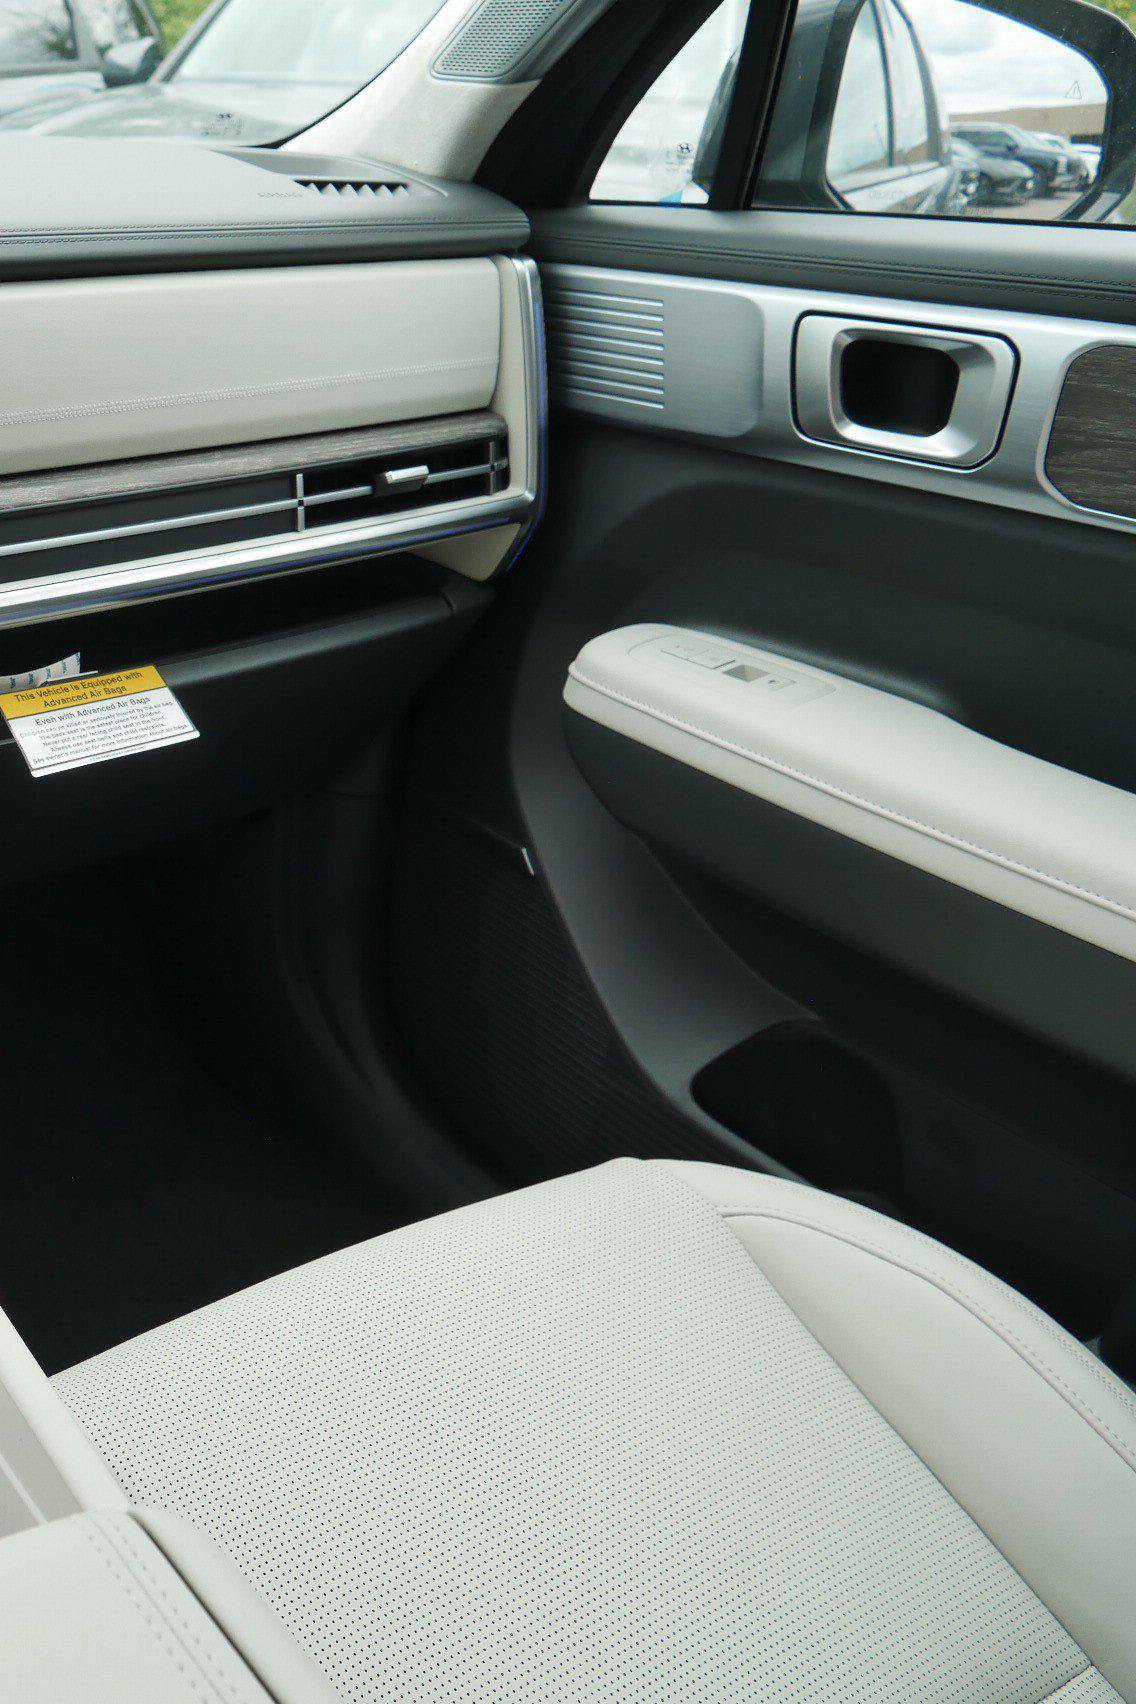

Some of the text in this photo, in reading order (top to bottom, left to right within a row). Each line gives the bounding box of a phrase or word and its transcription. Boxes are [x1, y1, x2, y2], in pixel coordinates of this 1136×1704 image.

[14, 693, 35, 702] This
[36, 686, 70, 698] Vehicle
[81, 676, 123, 691] Equipped
[123, 672, 143, 681] with
[43, 685, 128, 707] Advanced Air Bags
[35, 716, 57, 726] Even
[57, 712, 76, 721] with
[76, 704, 116, 717] Advanced
[129, 696, 152, 707] Bags
